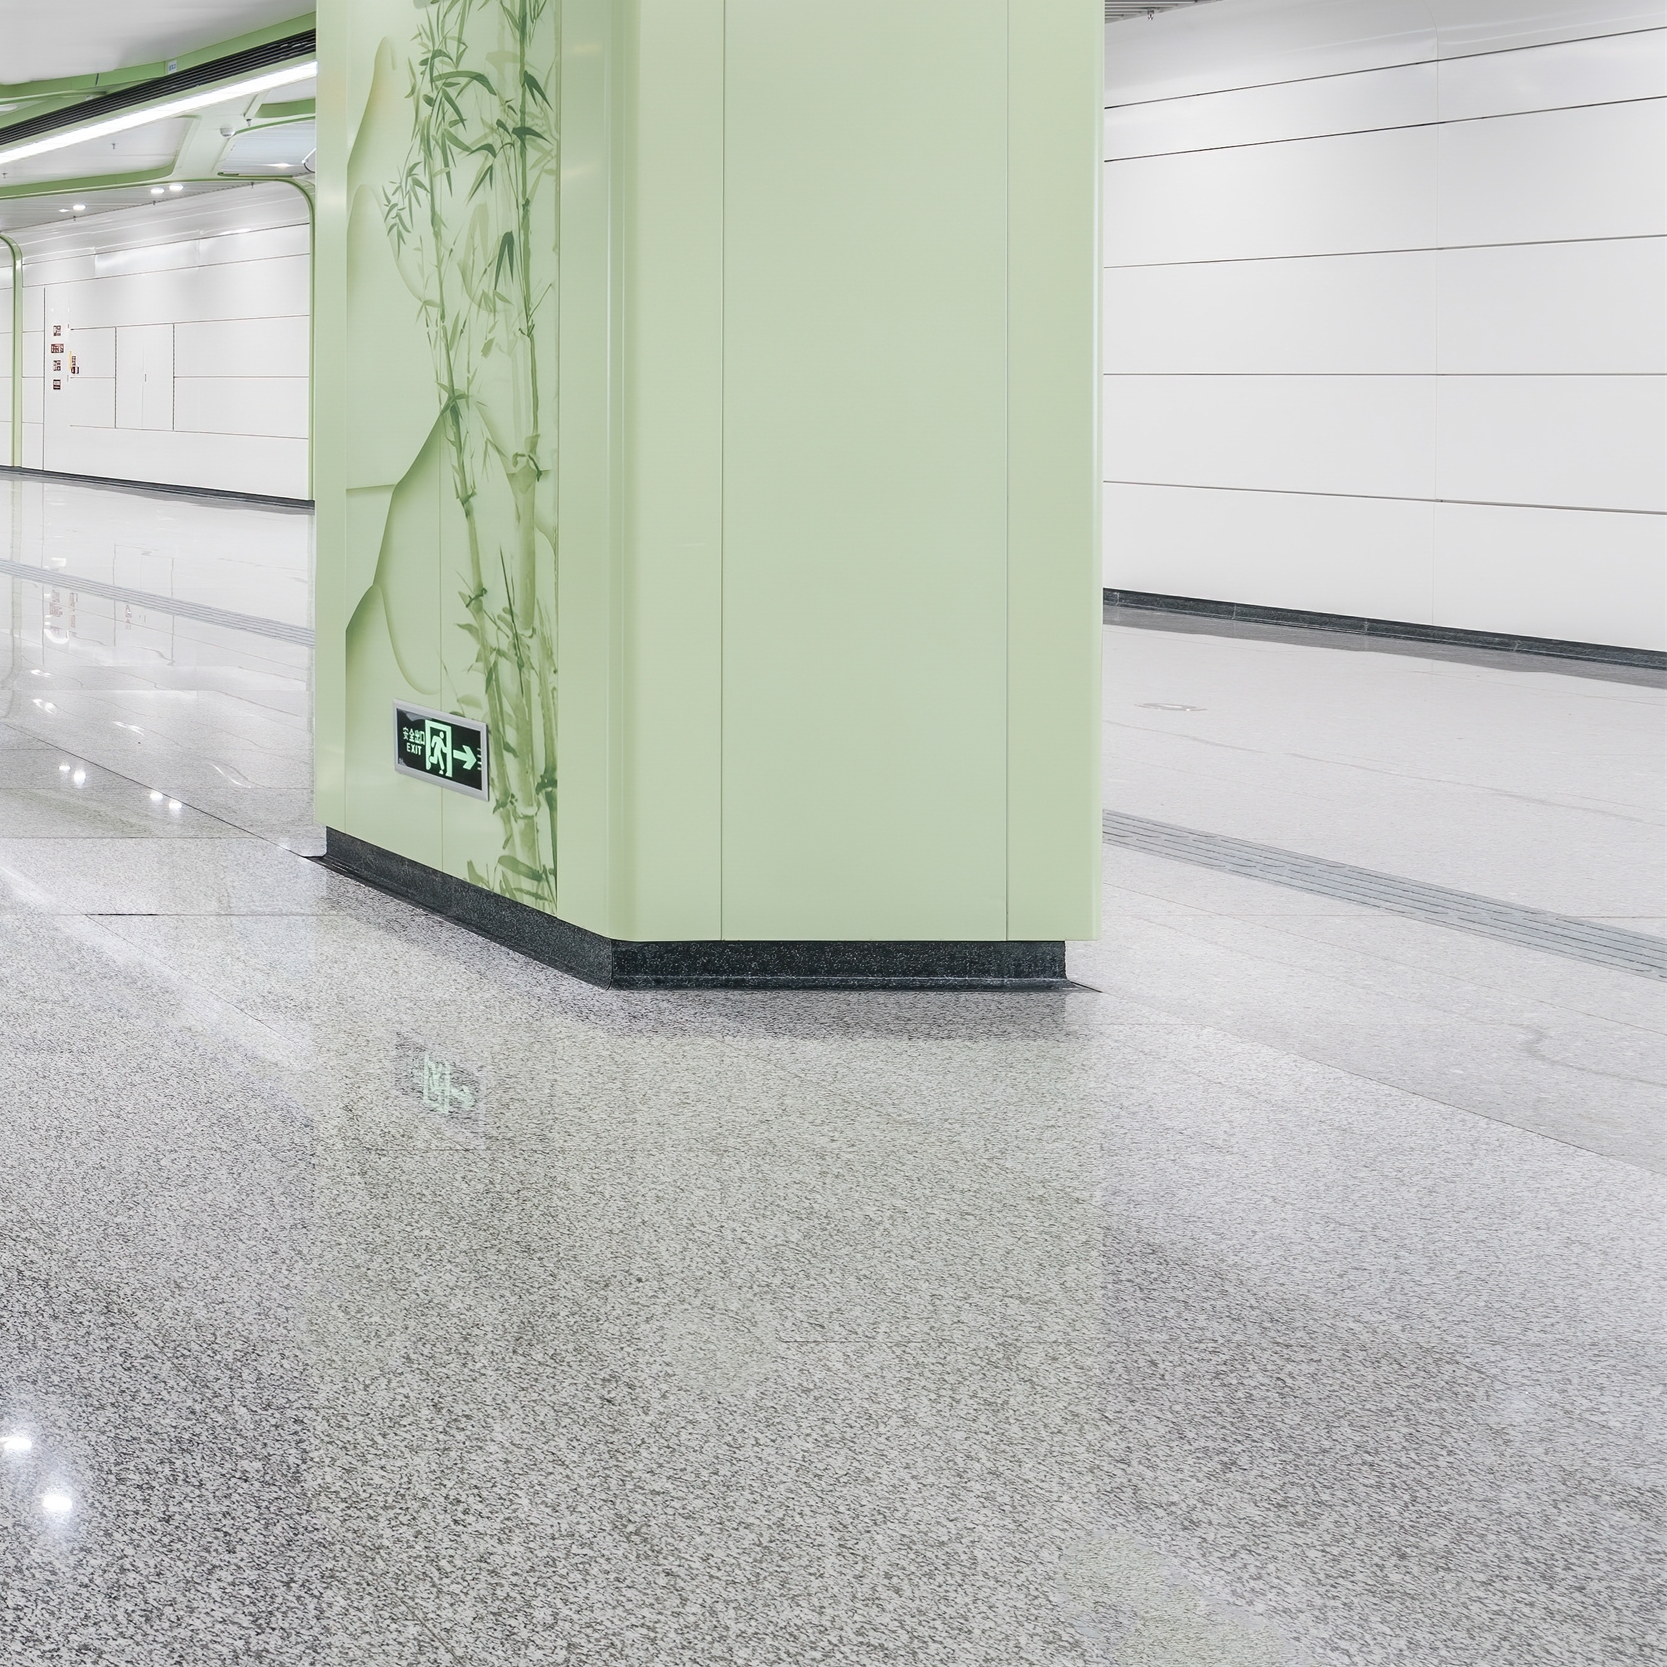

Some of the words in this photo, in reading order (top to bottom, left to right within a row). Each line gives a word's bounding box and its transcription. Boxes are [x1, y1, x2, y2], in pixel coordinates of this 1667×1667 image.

[402, 726, 426, 745] 安全出口
[406, 742, 422, 755] EXIT
